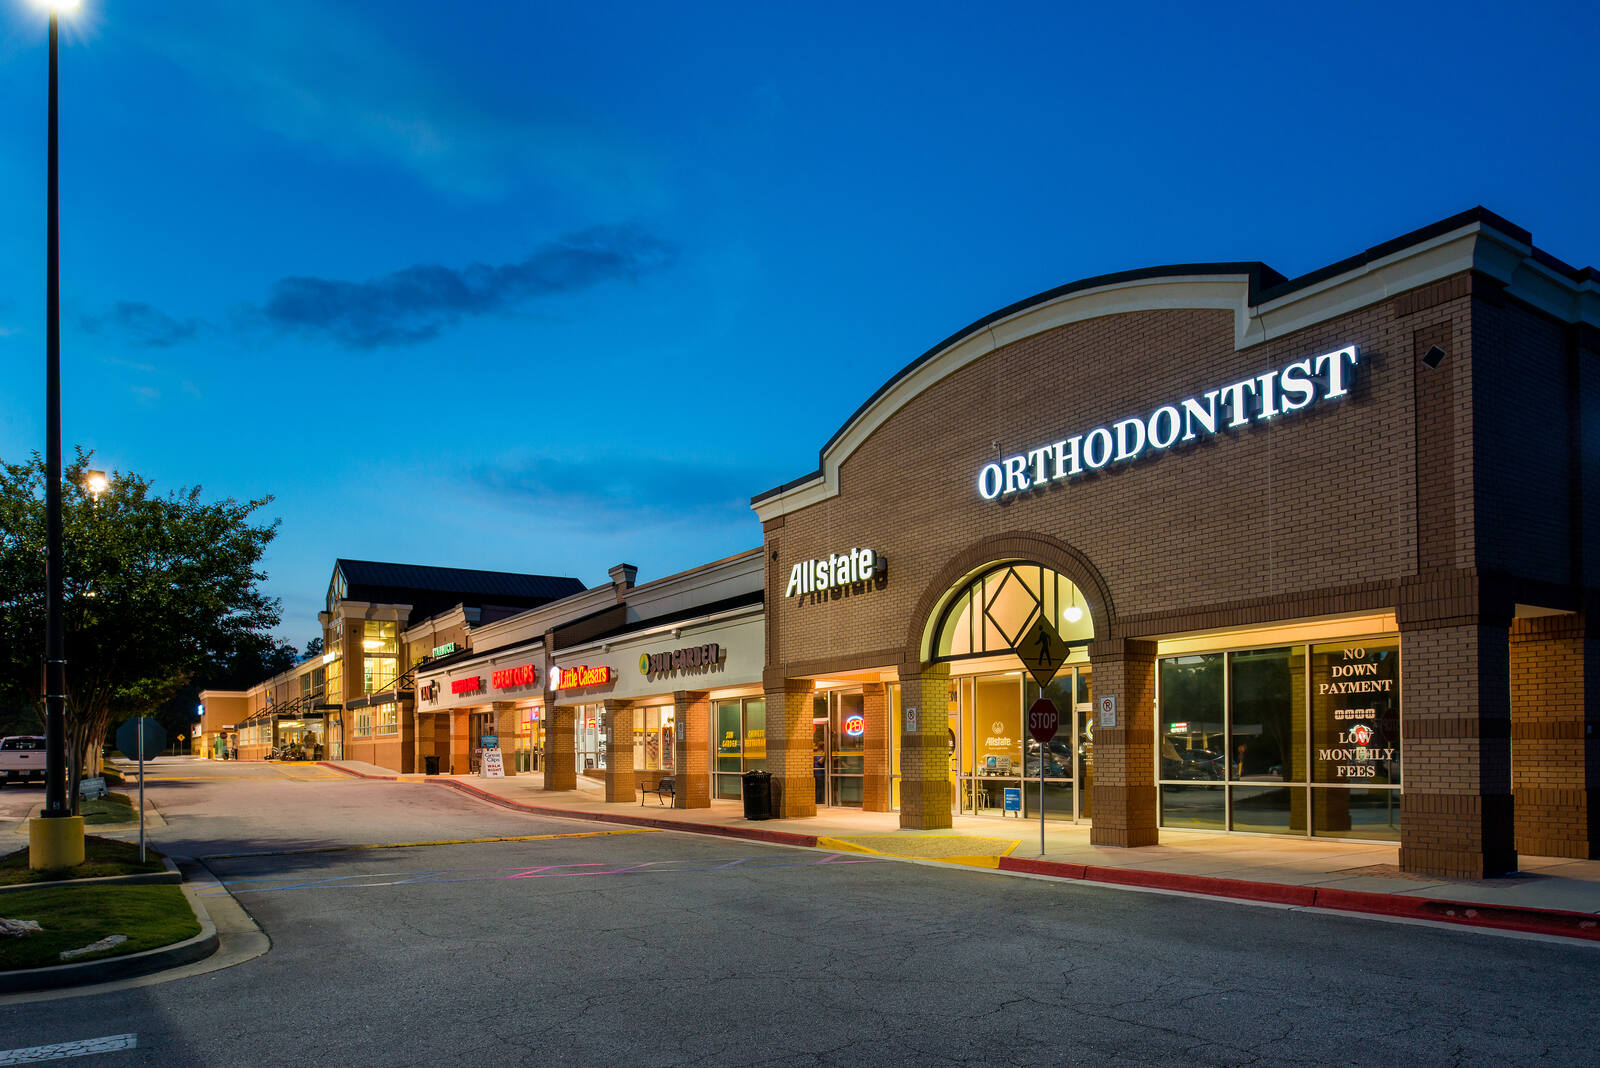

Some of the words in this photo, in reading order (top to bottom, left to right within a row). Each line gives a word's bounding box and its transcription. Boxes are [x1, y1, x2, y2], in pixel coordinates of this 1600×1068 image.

[978, 345, 1358, 500] ORTHODONTIST
[785, 547, 873, 598] Allstate
[649, 652, 670, 672] SUN
[672, 644, 718, 669] GARDEN
[1343, 647, 1365, 660] NO
[492, 668, 513, 690] GREAT
[514, 664, 534, 685] CLIPS
[560, 667, 578, 688] Little
[579, 665, 608, 686] Caesars
[1332, 663, 1378, 678] DOWN
[1319, 679, 1393, 695] PAYMENT
[845, 720, 864, 733] OPEN
[1030, 713, 1057, 729] STOP
[985, 737, 1011, 746] Allstate
[1338, 732, 1374, 744] LOW
[1319, 748, 1395, 761] MONTHLY
[1336, 765, 1375, 777] FEES
